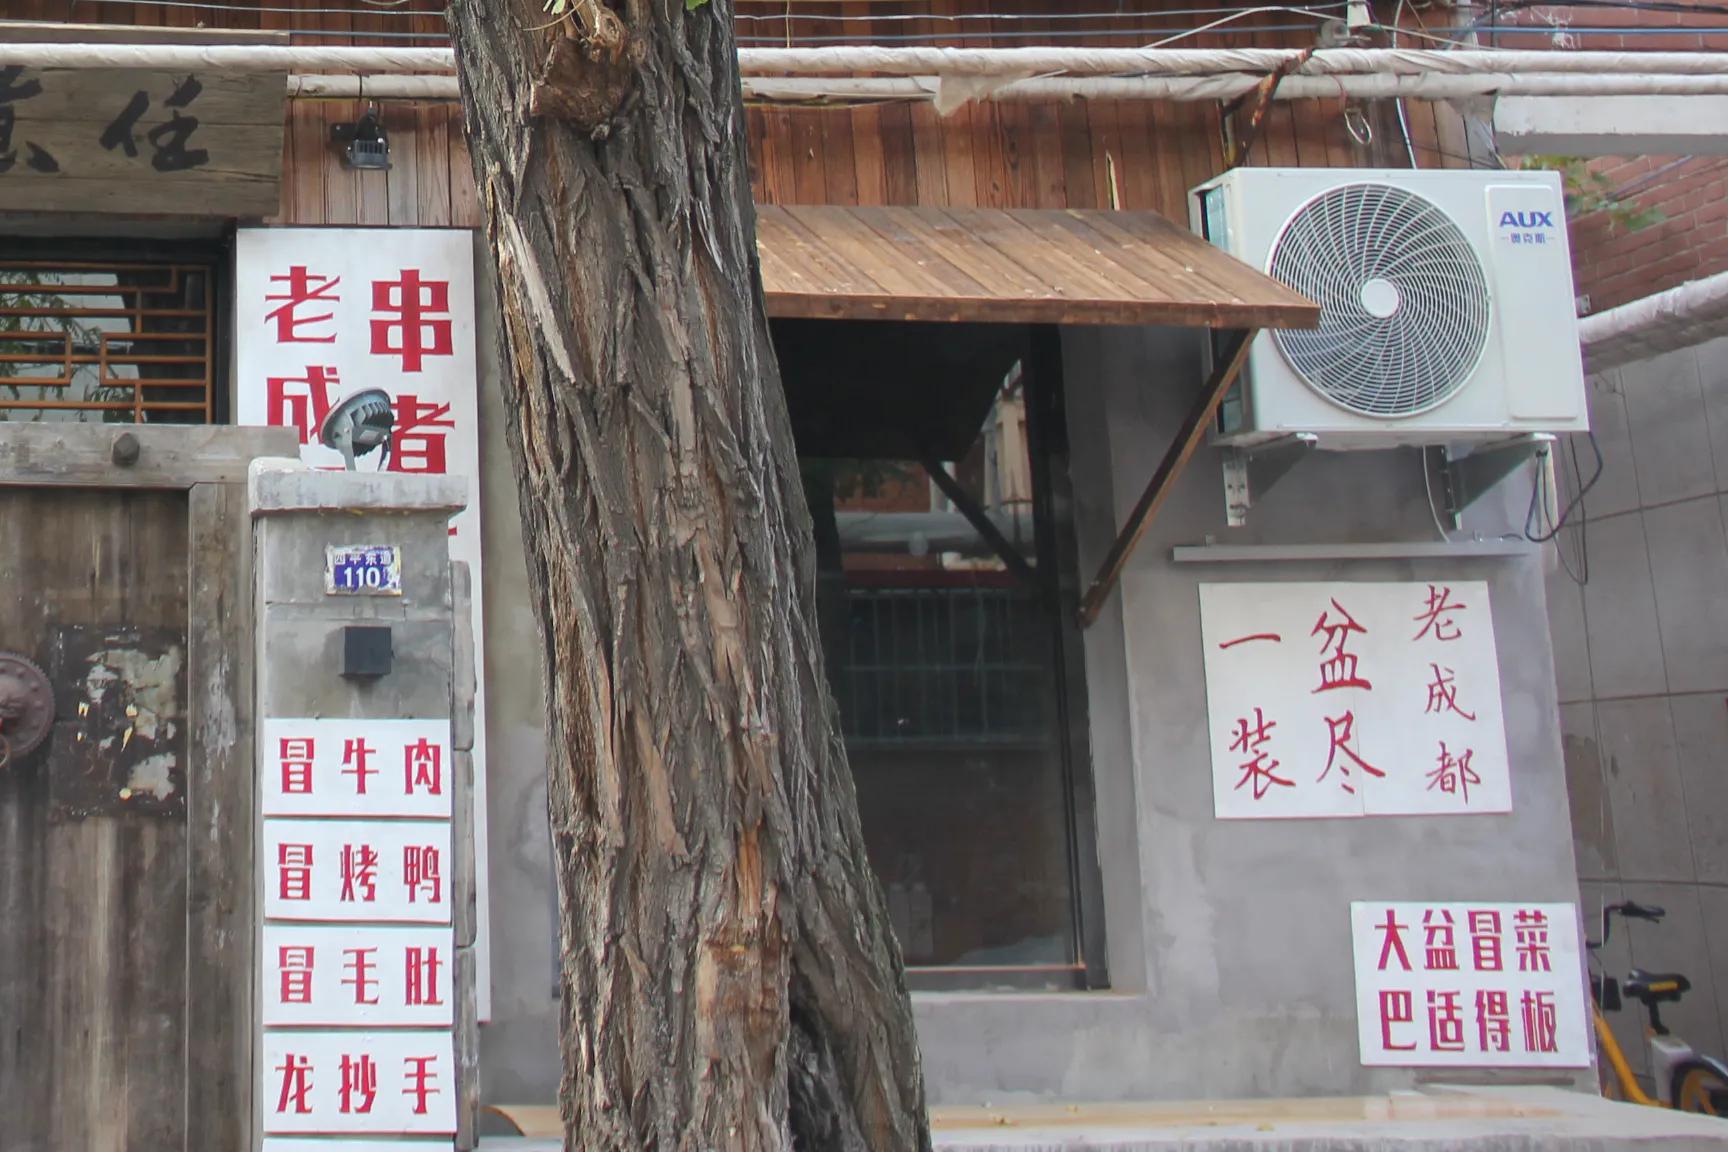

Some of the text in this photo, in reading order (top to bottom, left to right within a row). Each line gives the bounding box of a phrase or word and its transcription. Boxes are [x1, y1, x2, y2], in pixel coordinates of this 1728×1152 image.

[1500, 211, 1553, 228] AUX
[344, 567, 380, 588] 110
[1412, 585, 1481, 804] 老成都
[279, 737, 443, 796] 冒牛肉
[278, 843, 442, 904] 冒烤鸭
[1374, 909, 1552, 973] 大盆冒菜
[278, 945, 444, 1006] 冒毛肚
[1378, 990, 1558, 1053] 巴适得板
[274, 1053, 441, 1116] 龙抄手
